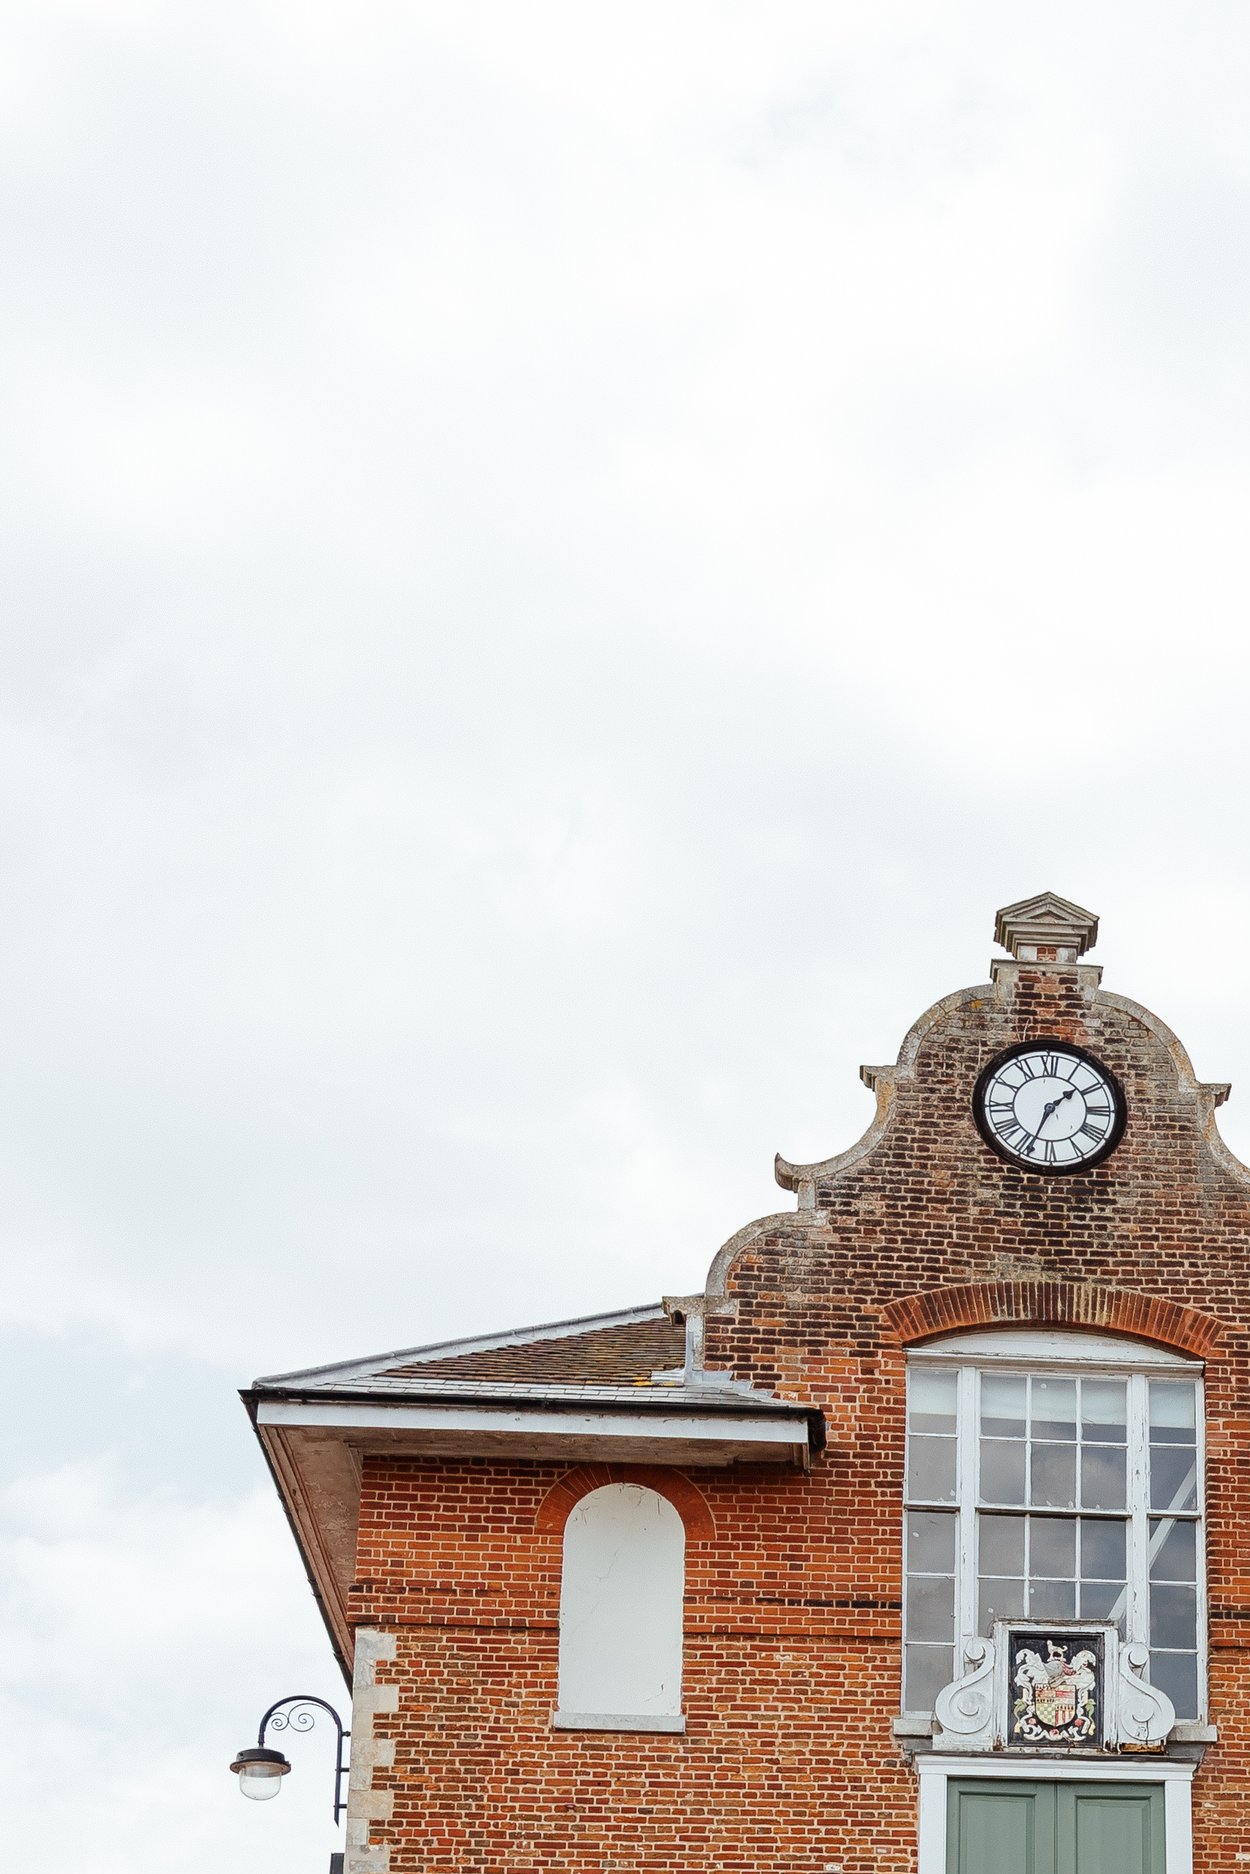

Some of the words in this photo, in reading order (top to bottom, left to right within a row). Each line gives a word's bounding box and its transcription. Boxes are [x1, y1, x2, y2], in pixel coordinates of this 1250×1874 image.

[1014, 1060, 1035, 1080] XI
[1041, 1056, 1059, 1076] XII
[996, 1078, 1019, 1093] X
[1080, 1082, 1102, 1096] II
[990, 1100, 1014, 1112] IX
[1086, 1106, 1110, 1116] III
[993, 1118, 1021, 1141] VIII
[1080, 1122, 1106, 1144] IIII
[1044, 1141, 1057, 1161] VI
[1069, 1138, 1084, 1157] V
